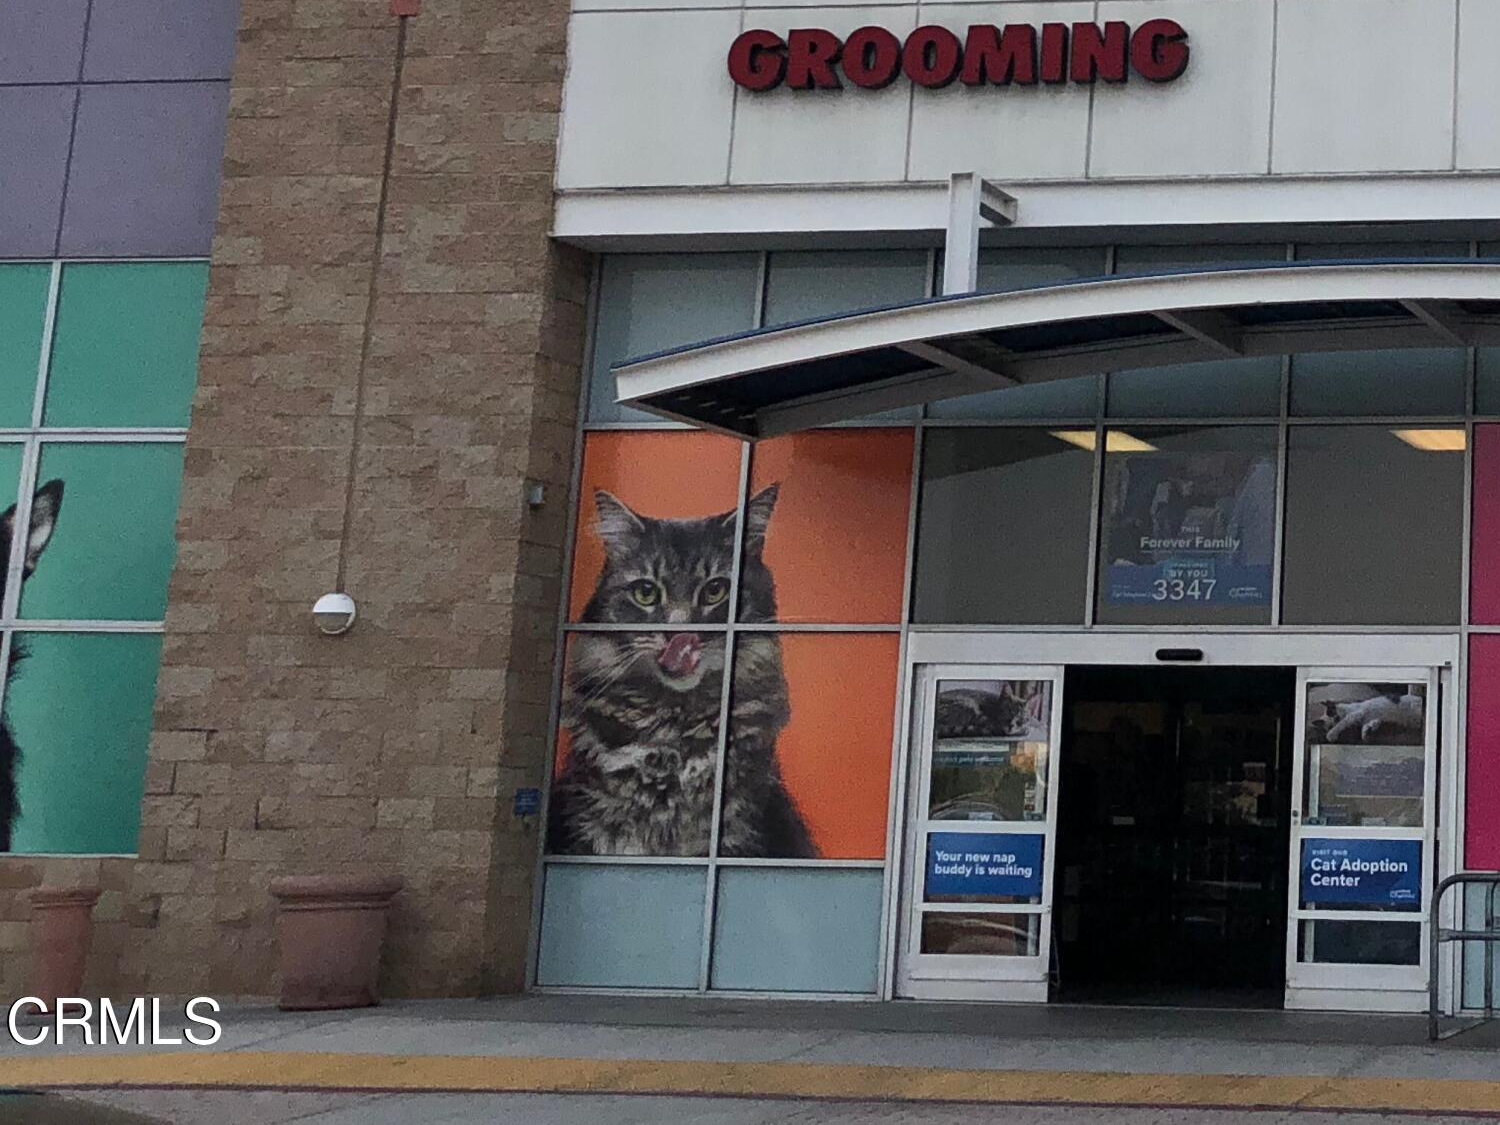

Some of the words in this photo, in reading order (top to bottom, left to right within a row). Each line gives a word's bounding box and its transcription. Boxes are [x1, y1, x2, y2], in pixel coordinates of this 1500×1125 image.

[727, 18, 1190, 91] GROOMING
[1140, 536, 1190, 548] Forever
[1195, 535, 1240, 551] Family
[1187, 569, 1208, 577] YOU
[1152, 579, 1217, 601] 3347
[935, 851, 962, 862] Your
[965, 853, 990, 862] new
[993, 853, 1016, 865] nap
[934, 864, 973, 878] buddy
[975, 864, 985, 875] is
[988, 864, 1032, 878] waiting
[1311, 857, 1337, 871] Cat
[1340, 857, 1408, 875] Adoption
[1310, 873, 1360, 887] Center
